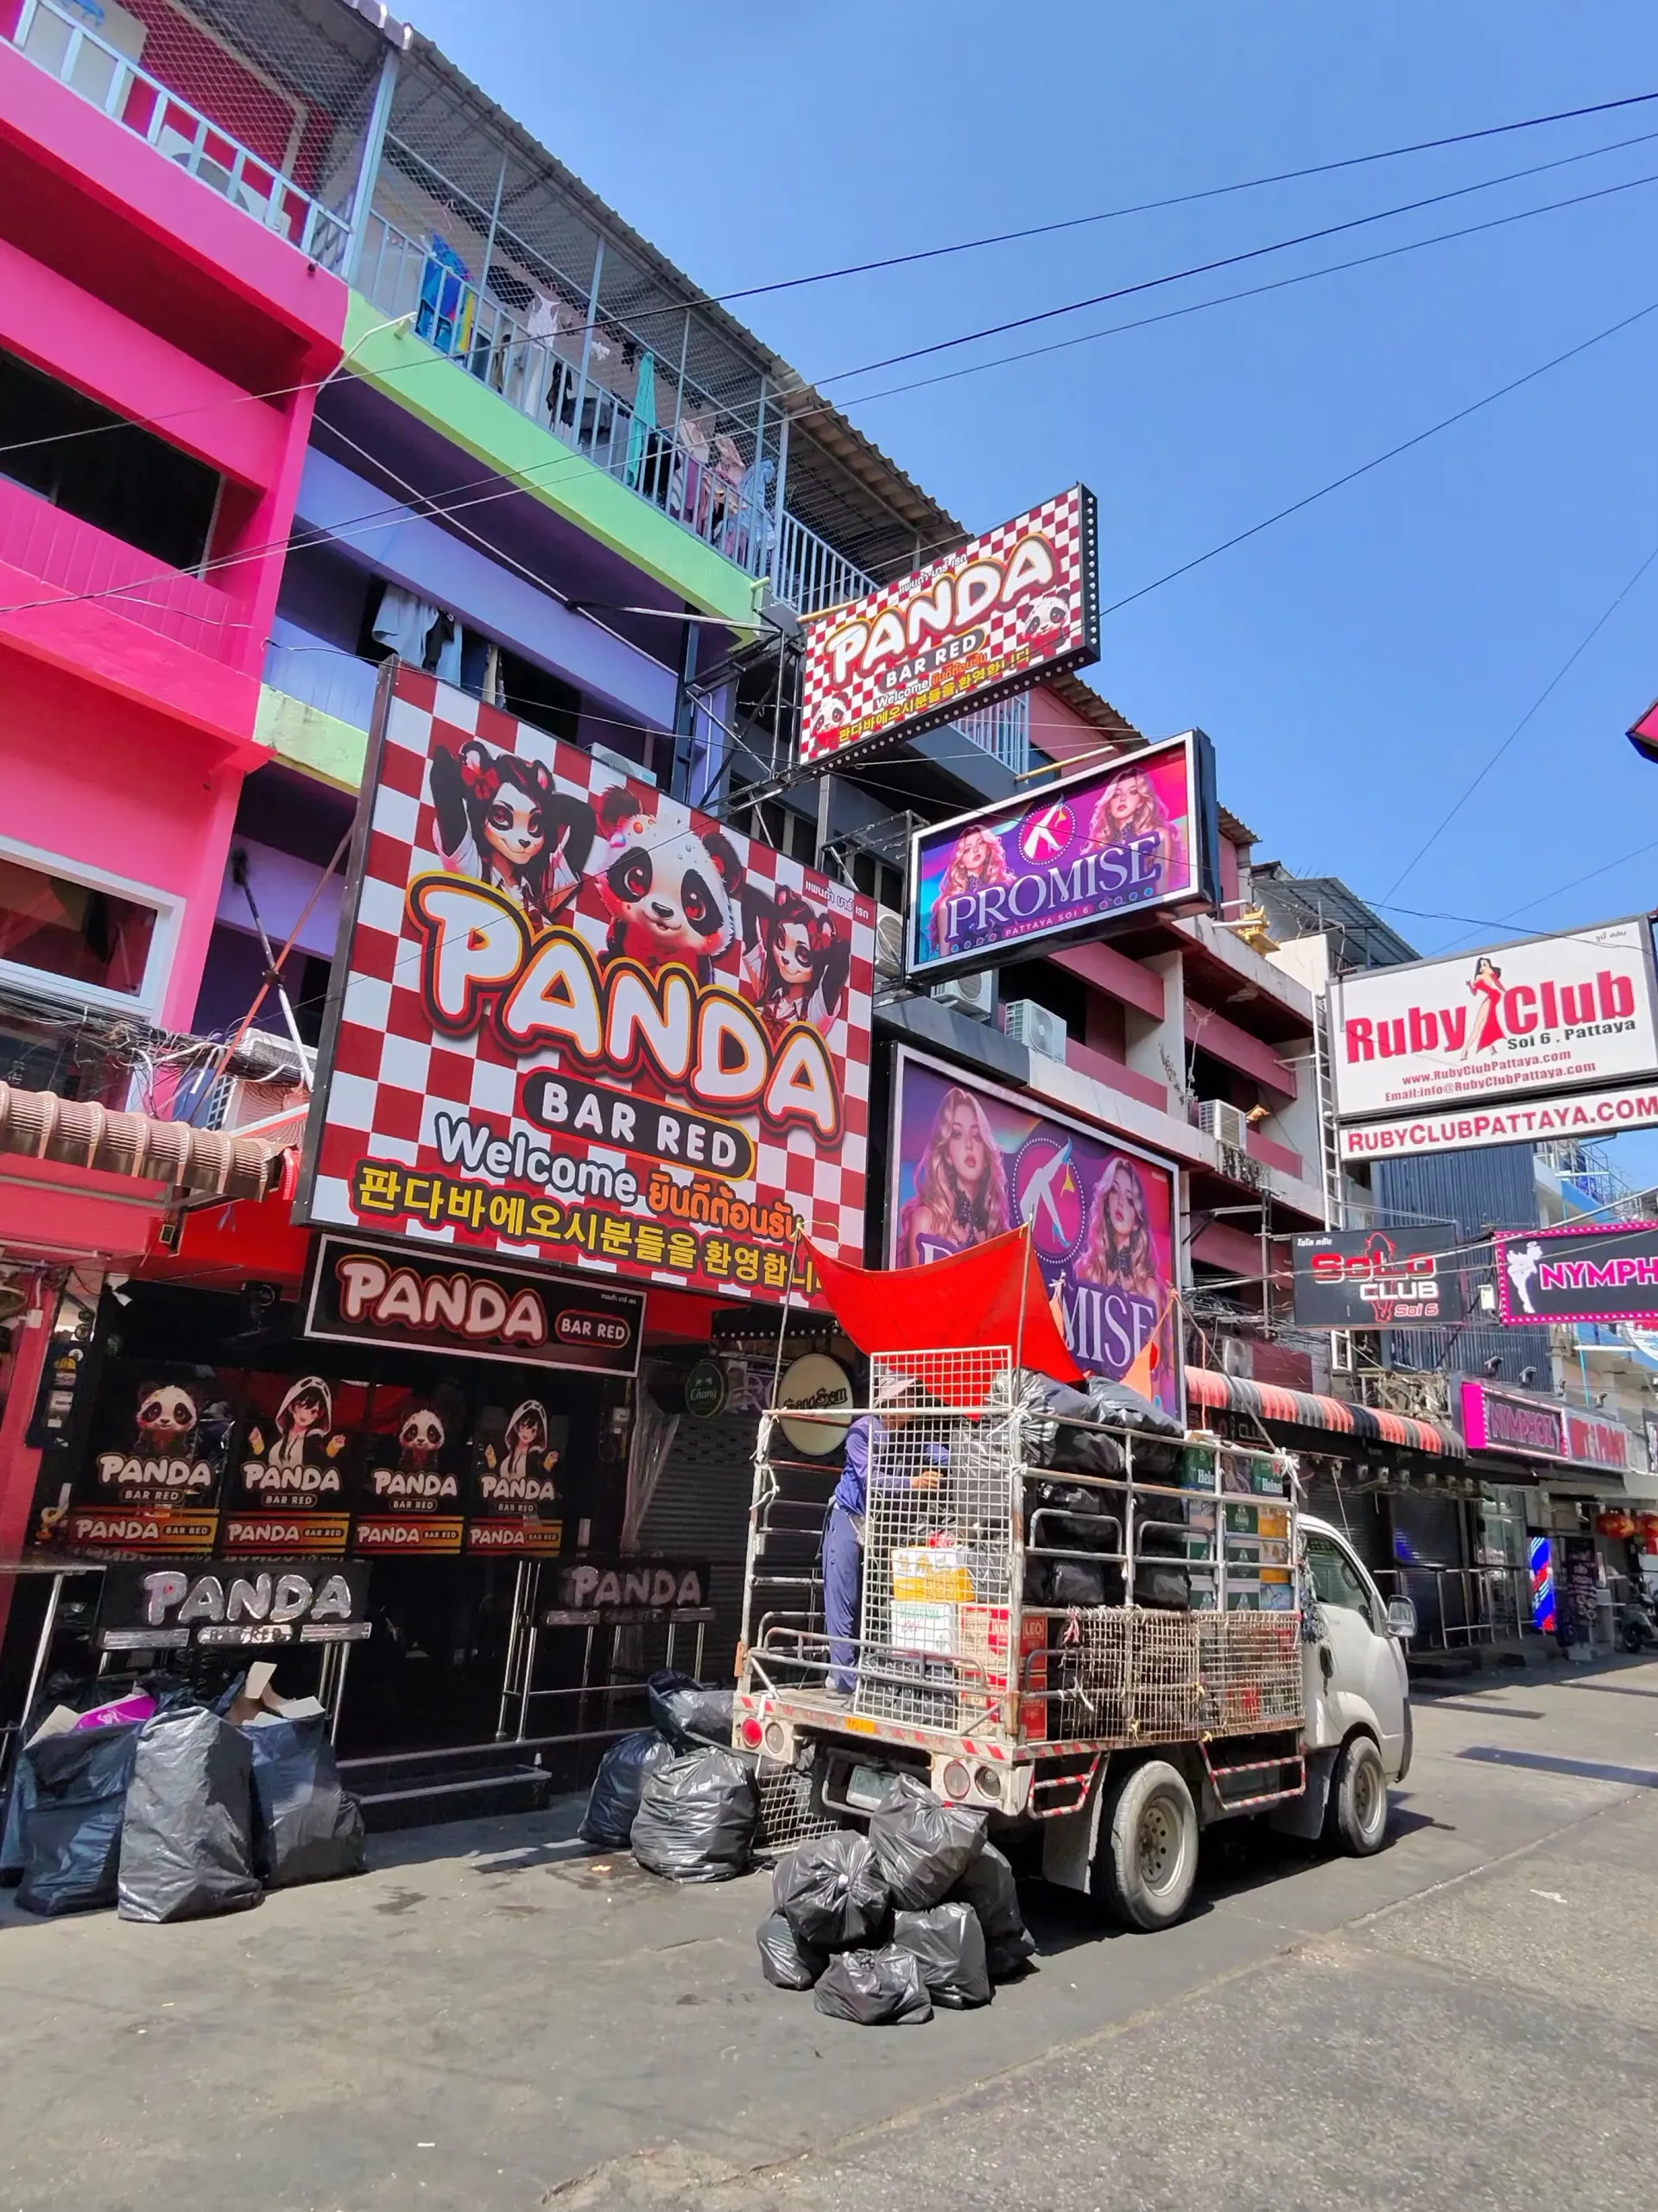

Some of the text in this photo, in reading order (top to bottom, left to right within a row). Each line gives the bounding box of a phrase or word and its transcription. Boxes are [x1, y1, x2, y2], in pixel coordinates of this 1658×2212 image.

[826, 535, 1054, 685] PANDA
[885, 635, 977, 688] BAR RED
[876, 680, 928, 711] Welcome
[946, 837, 1161, 939] PROMISE
[1004, 907, 1090, 937] PATTAYA SOI 6
[414, 878, 840, 1137] PANDA
[1345, 970, 1636, 1065] Ruby Club
[1507, 1034, 1535, 1051] Soi
[1540, 1032, 1551, 1046] 6
[1565, 1017, 1636, 1042] Pattaya
[1384, 1061, 1597, 1103] Email:info@RubyClubPattaya.com
[1402, 1049, 1572, 1085] www.RubyClubPattaya.com
[541, 1081, 737, 1168] BAR RED
[1347, 1096, 1658, 1153] RUBYCLUBPATTAYA.COM
[437, 1115, 638, 1204] Welcome
[358, 1165, 822, 1293] 판다바에오시분들을 환영합니
[1539, 1256, 1658, 1291] NYMPH
[339, 1259, 545, 1343] PANDA
[1359, 1280, 1440, 1302] CLUB
[1425, 1302, 1440, 1317] 6
[561, 1317, 626, 1342] BAR RED
[690, 1387, 718, 1401] Chang
[98, 1454, 212, 1488] PANDA
[243, 1463, 341, 1492] PANDA
[372, 1470, 458, 1497] PANDA
[1262, 1477, 1283, 1494] Heine
[124, 1489, 180, 1501] BAR RED
[265, 1495, 313, 1506] BAR RED
[480, 1475, 556, 1501] PANDA
[393, 1500, 433, 1511] BAR RED
[497, 1503, 534, 1513] BAR RED
[75, 1519, 208, 1540] PANDA BAR RED
[228, 1522, 341, 1542] PANDA BAR RED
[357, 1525, 457, 1544] PANDA BAR RED
[469, 1527, 525, 1545] PANDA
[143, 1571, 351, 1626] PANDA
[570, 1564, 702, 1608] PANDA
